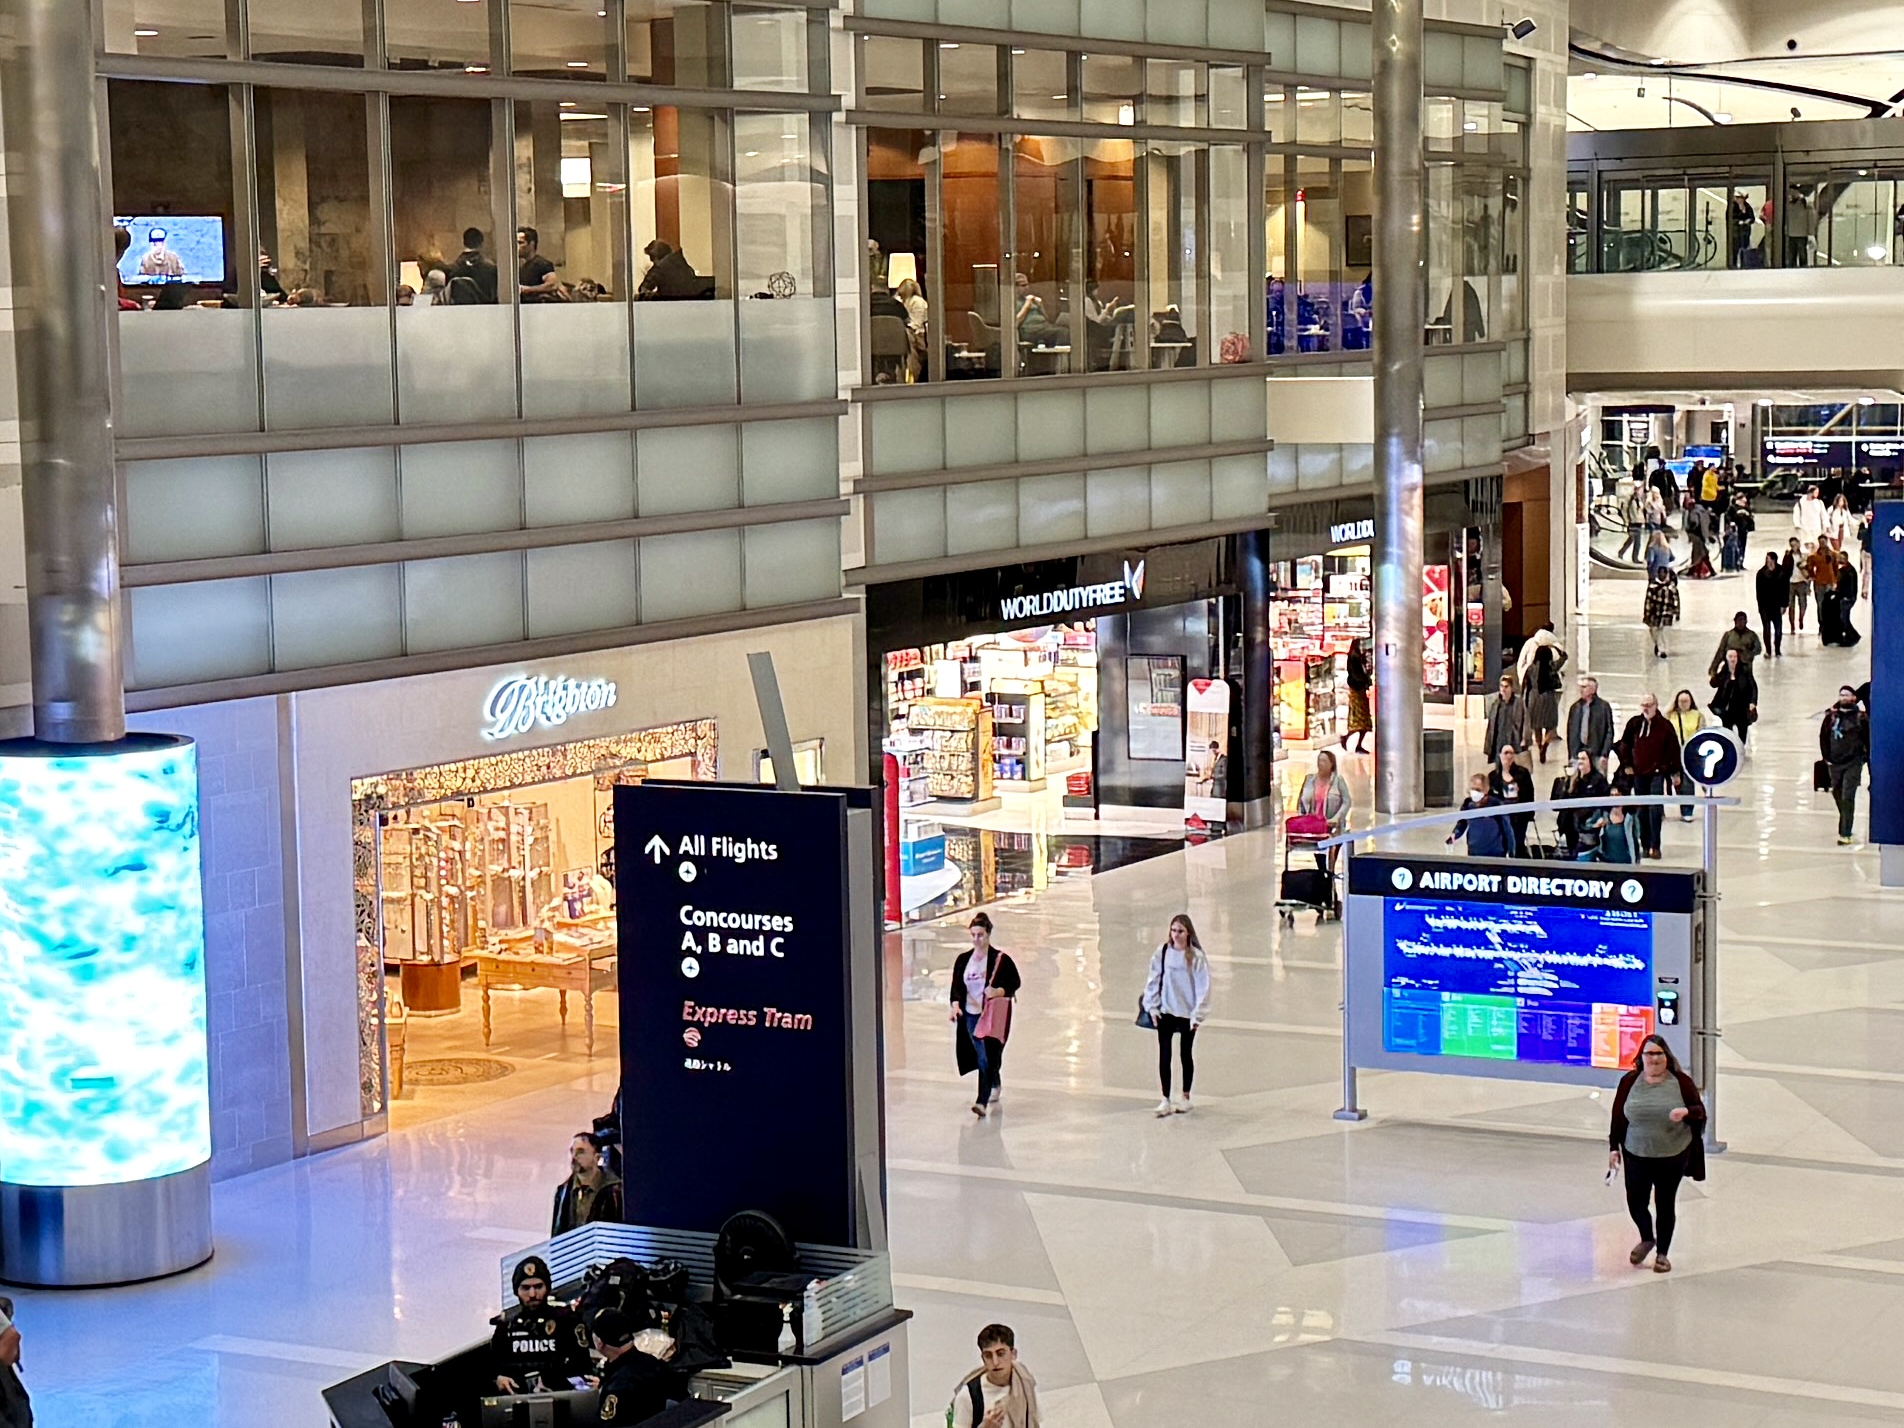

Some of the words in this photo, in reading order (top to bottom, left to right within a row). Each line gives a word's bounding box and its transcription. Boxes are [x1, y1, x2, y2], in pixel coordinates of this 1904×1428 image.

[482, 675, 617, 740] Brighton
[679, 834, 706, 856] All
[711, 836, 778, 863] Flights
[1419, 871, 1502, 893] AIRPORT
[1506, 875, 1614, 899] DIRECTORY
[679, 905, 794, 932] Concourses
[681, 931, 702, 955] A,
[708, 933, 722, 953] B
[727, 935, 765, 957] and
[770, 937, 785, 958] C
[682, 1000, 757, 1027] Express
[763, 1006, 813, 1031] Tram
[512, 1339, 556, 1353] POLICE
